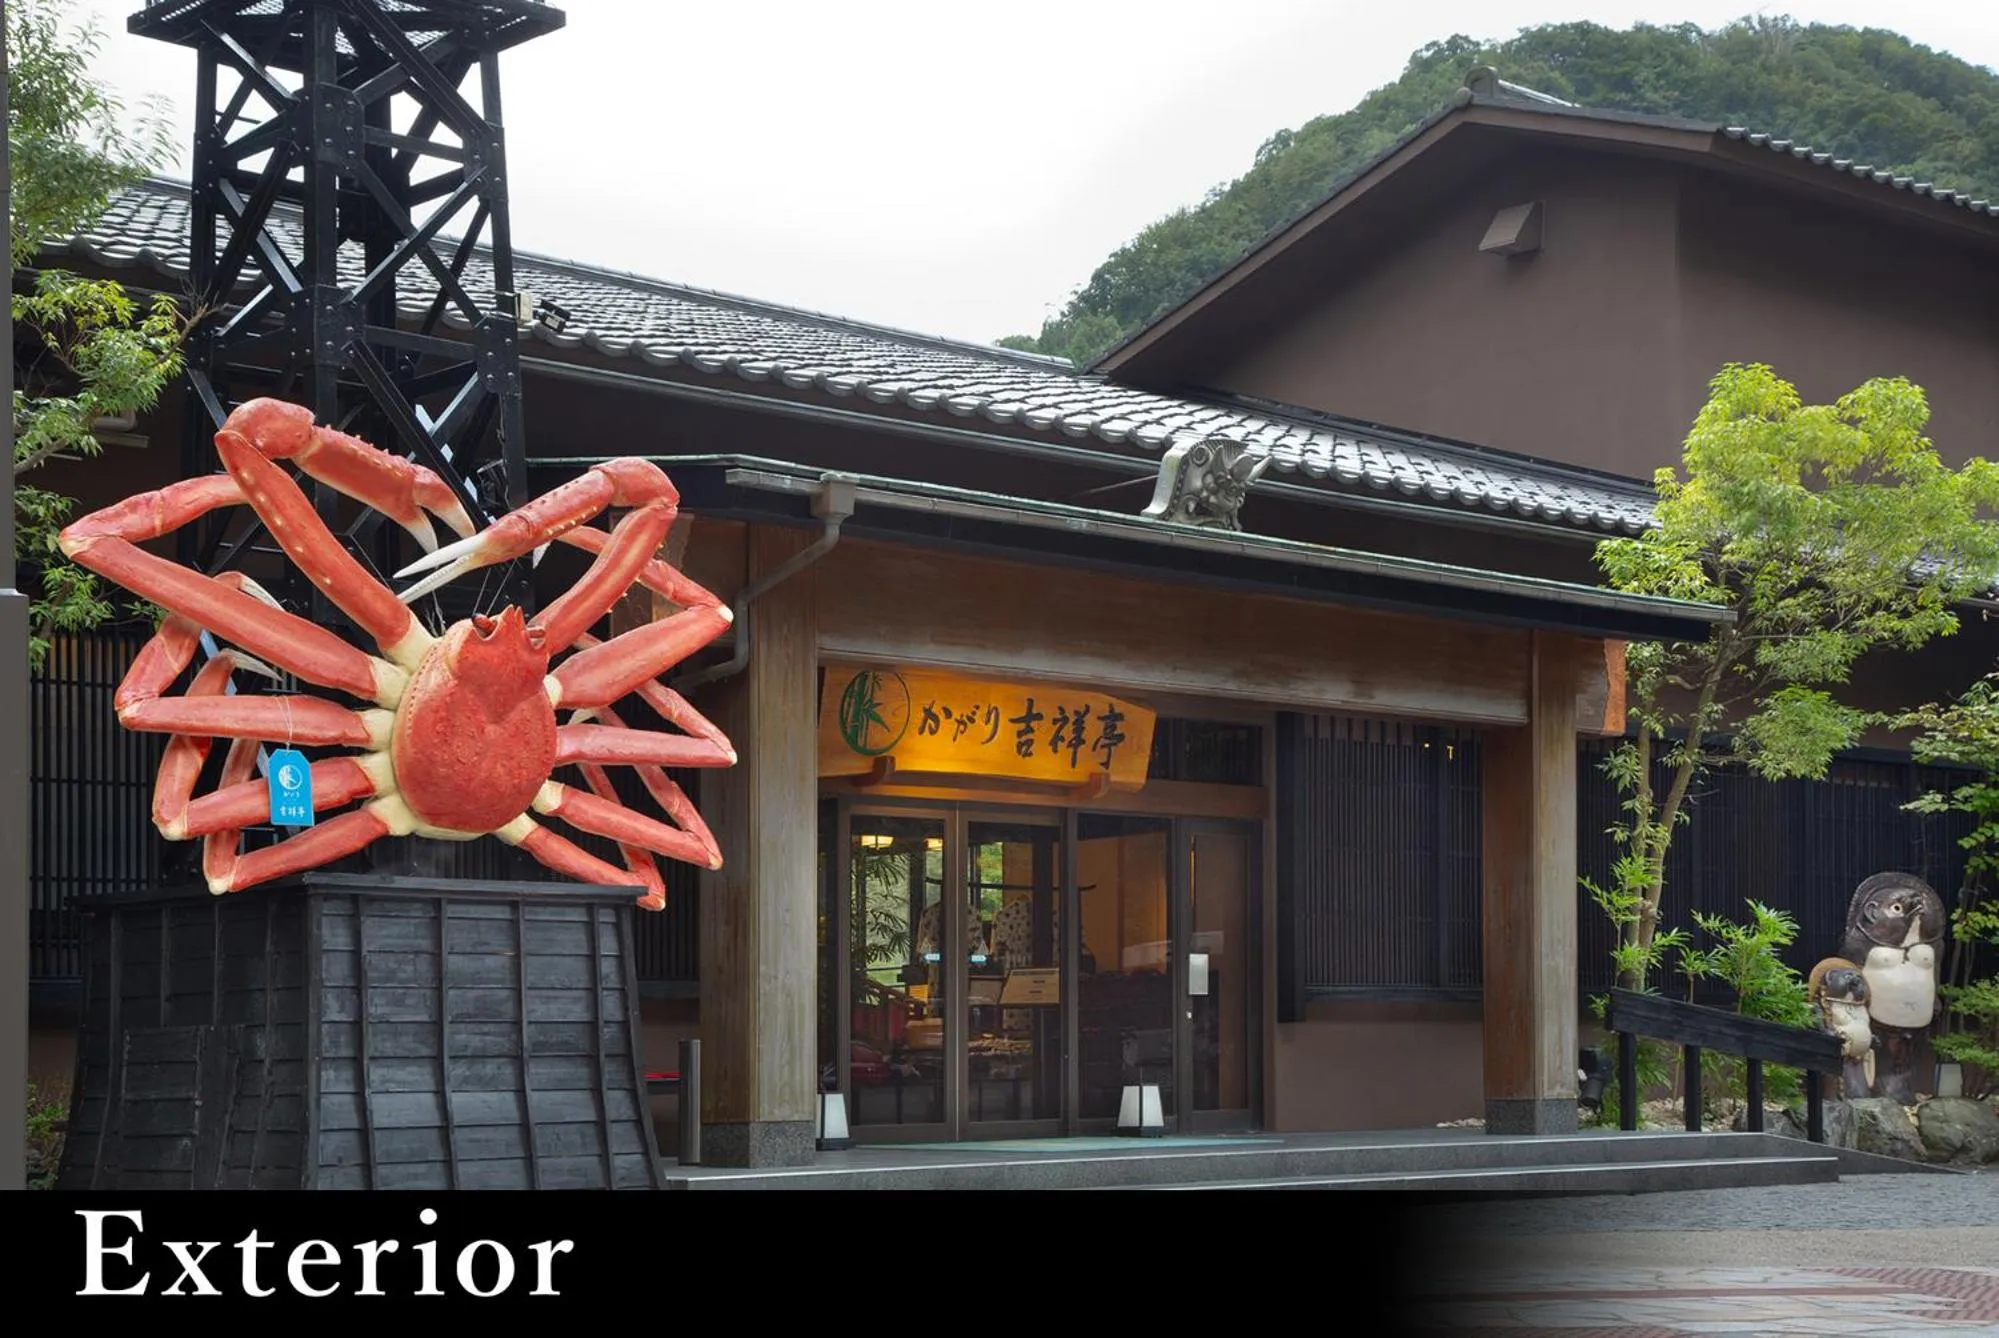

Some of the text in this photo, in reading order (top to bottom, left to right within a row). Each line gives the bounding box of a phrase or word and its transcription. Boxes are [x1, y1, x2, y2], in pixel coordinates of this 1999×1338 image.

[918, 698, 1125, 769] かがり吉祥亭
